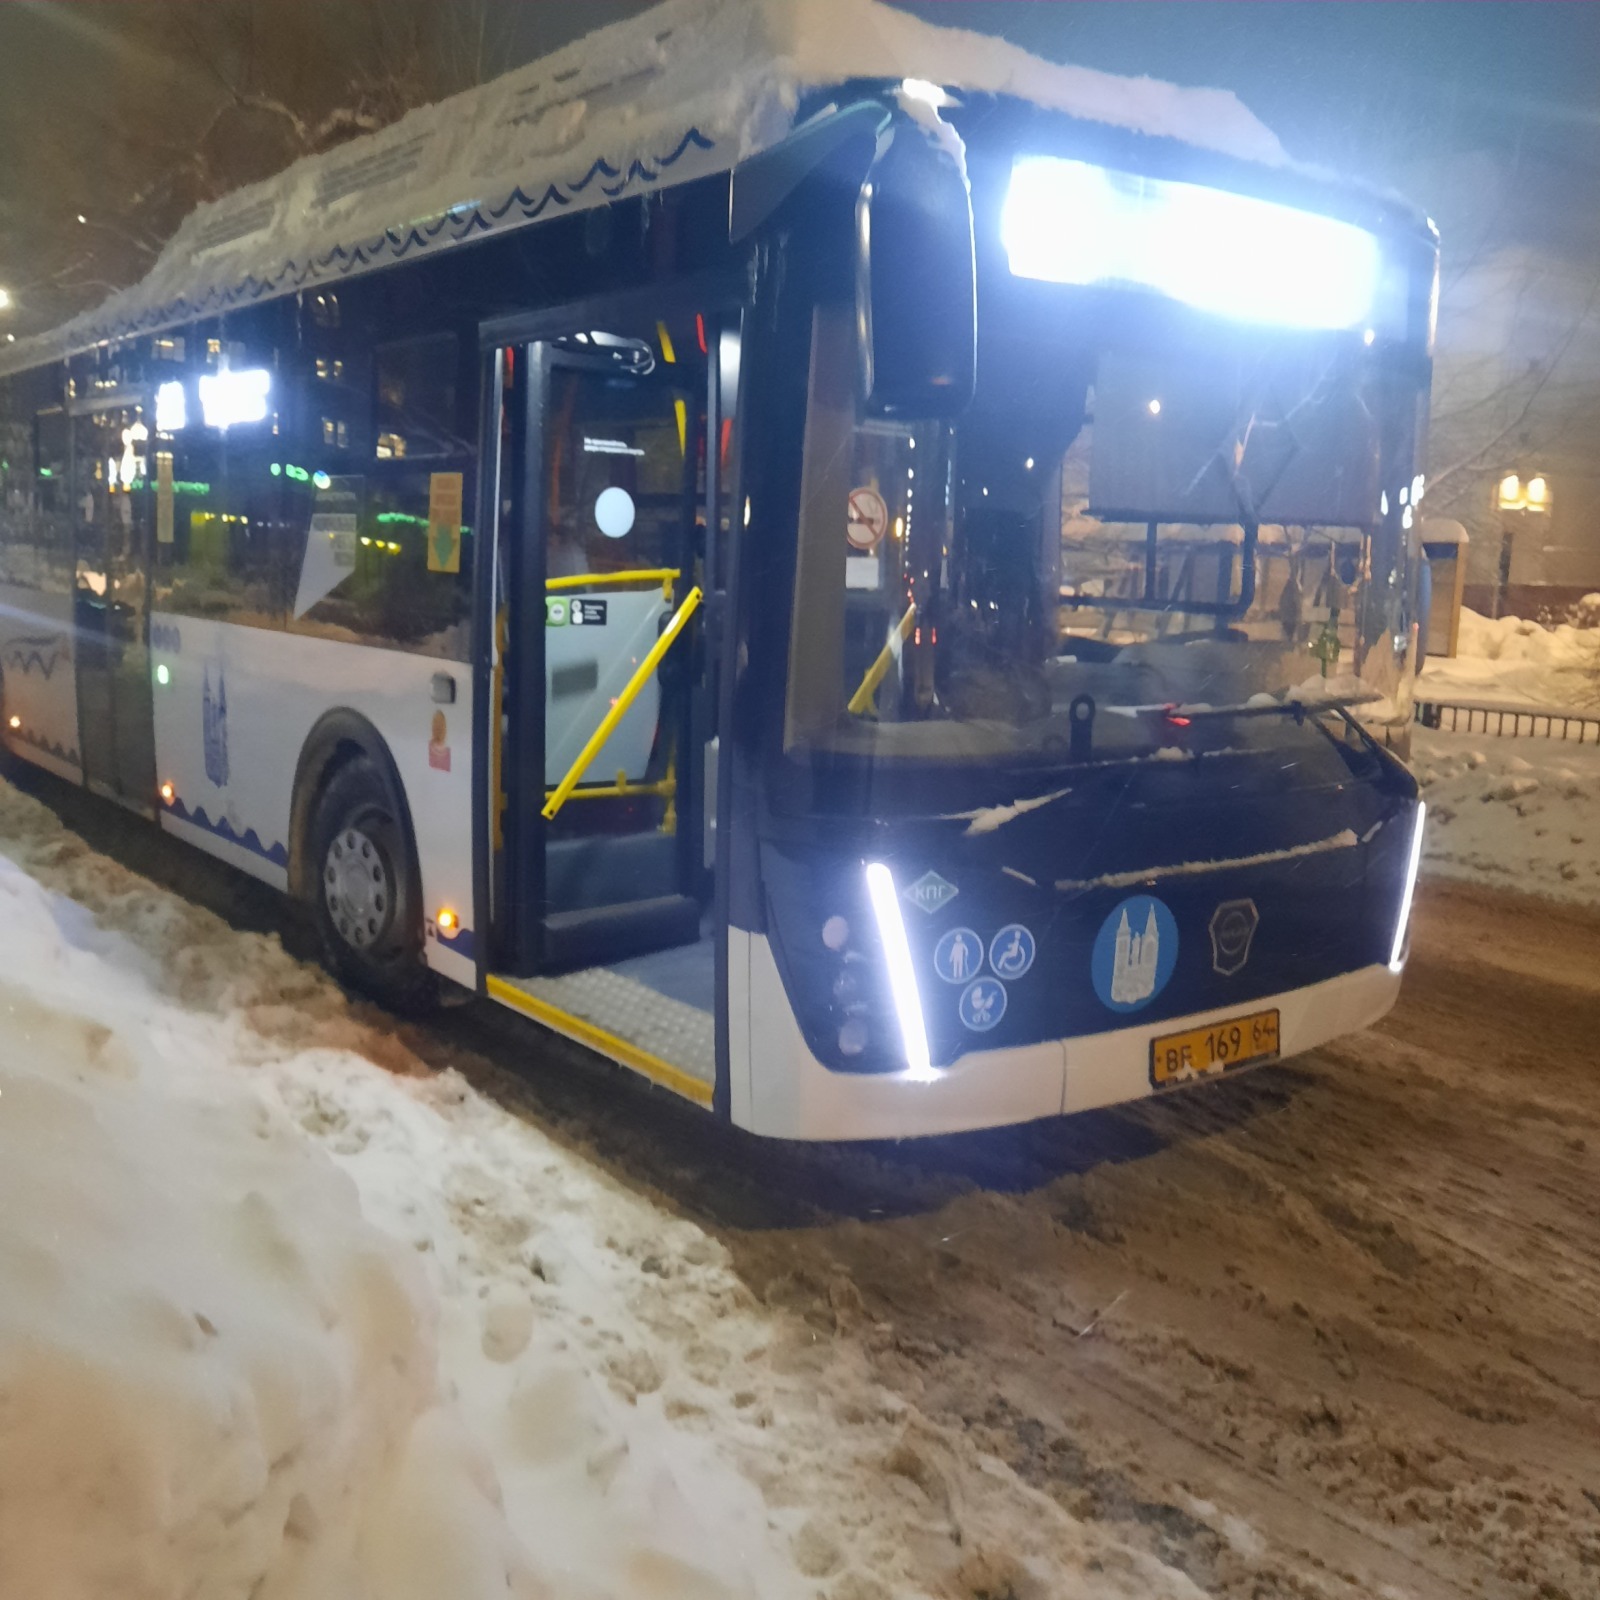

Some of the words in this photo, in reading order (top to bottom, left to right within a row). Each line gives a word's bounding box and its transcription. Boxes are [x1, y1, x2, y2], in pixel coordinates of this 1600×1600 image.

[914, 884, 947, 901] КПГ
[1205, 1026, 1242, 1062] 169
[1253, 1017, 1276, 1042] 64
